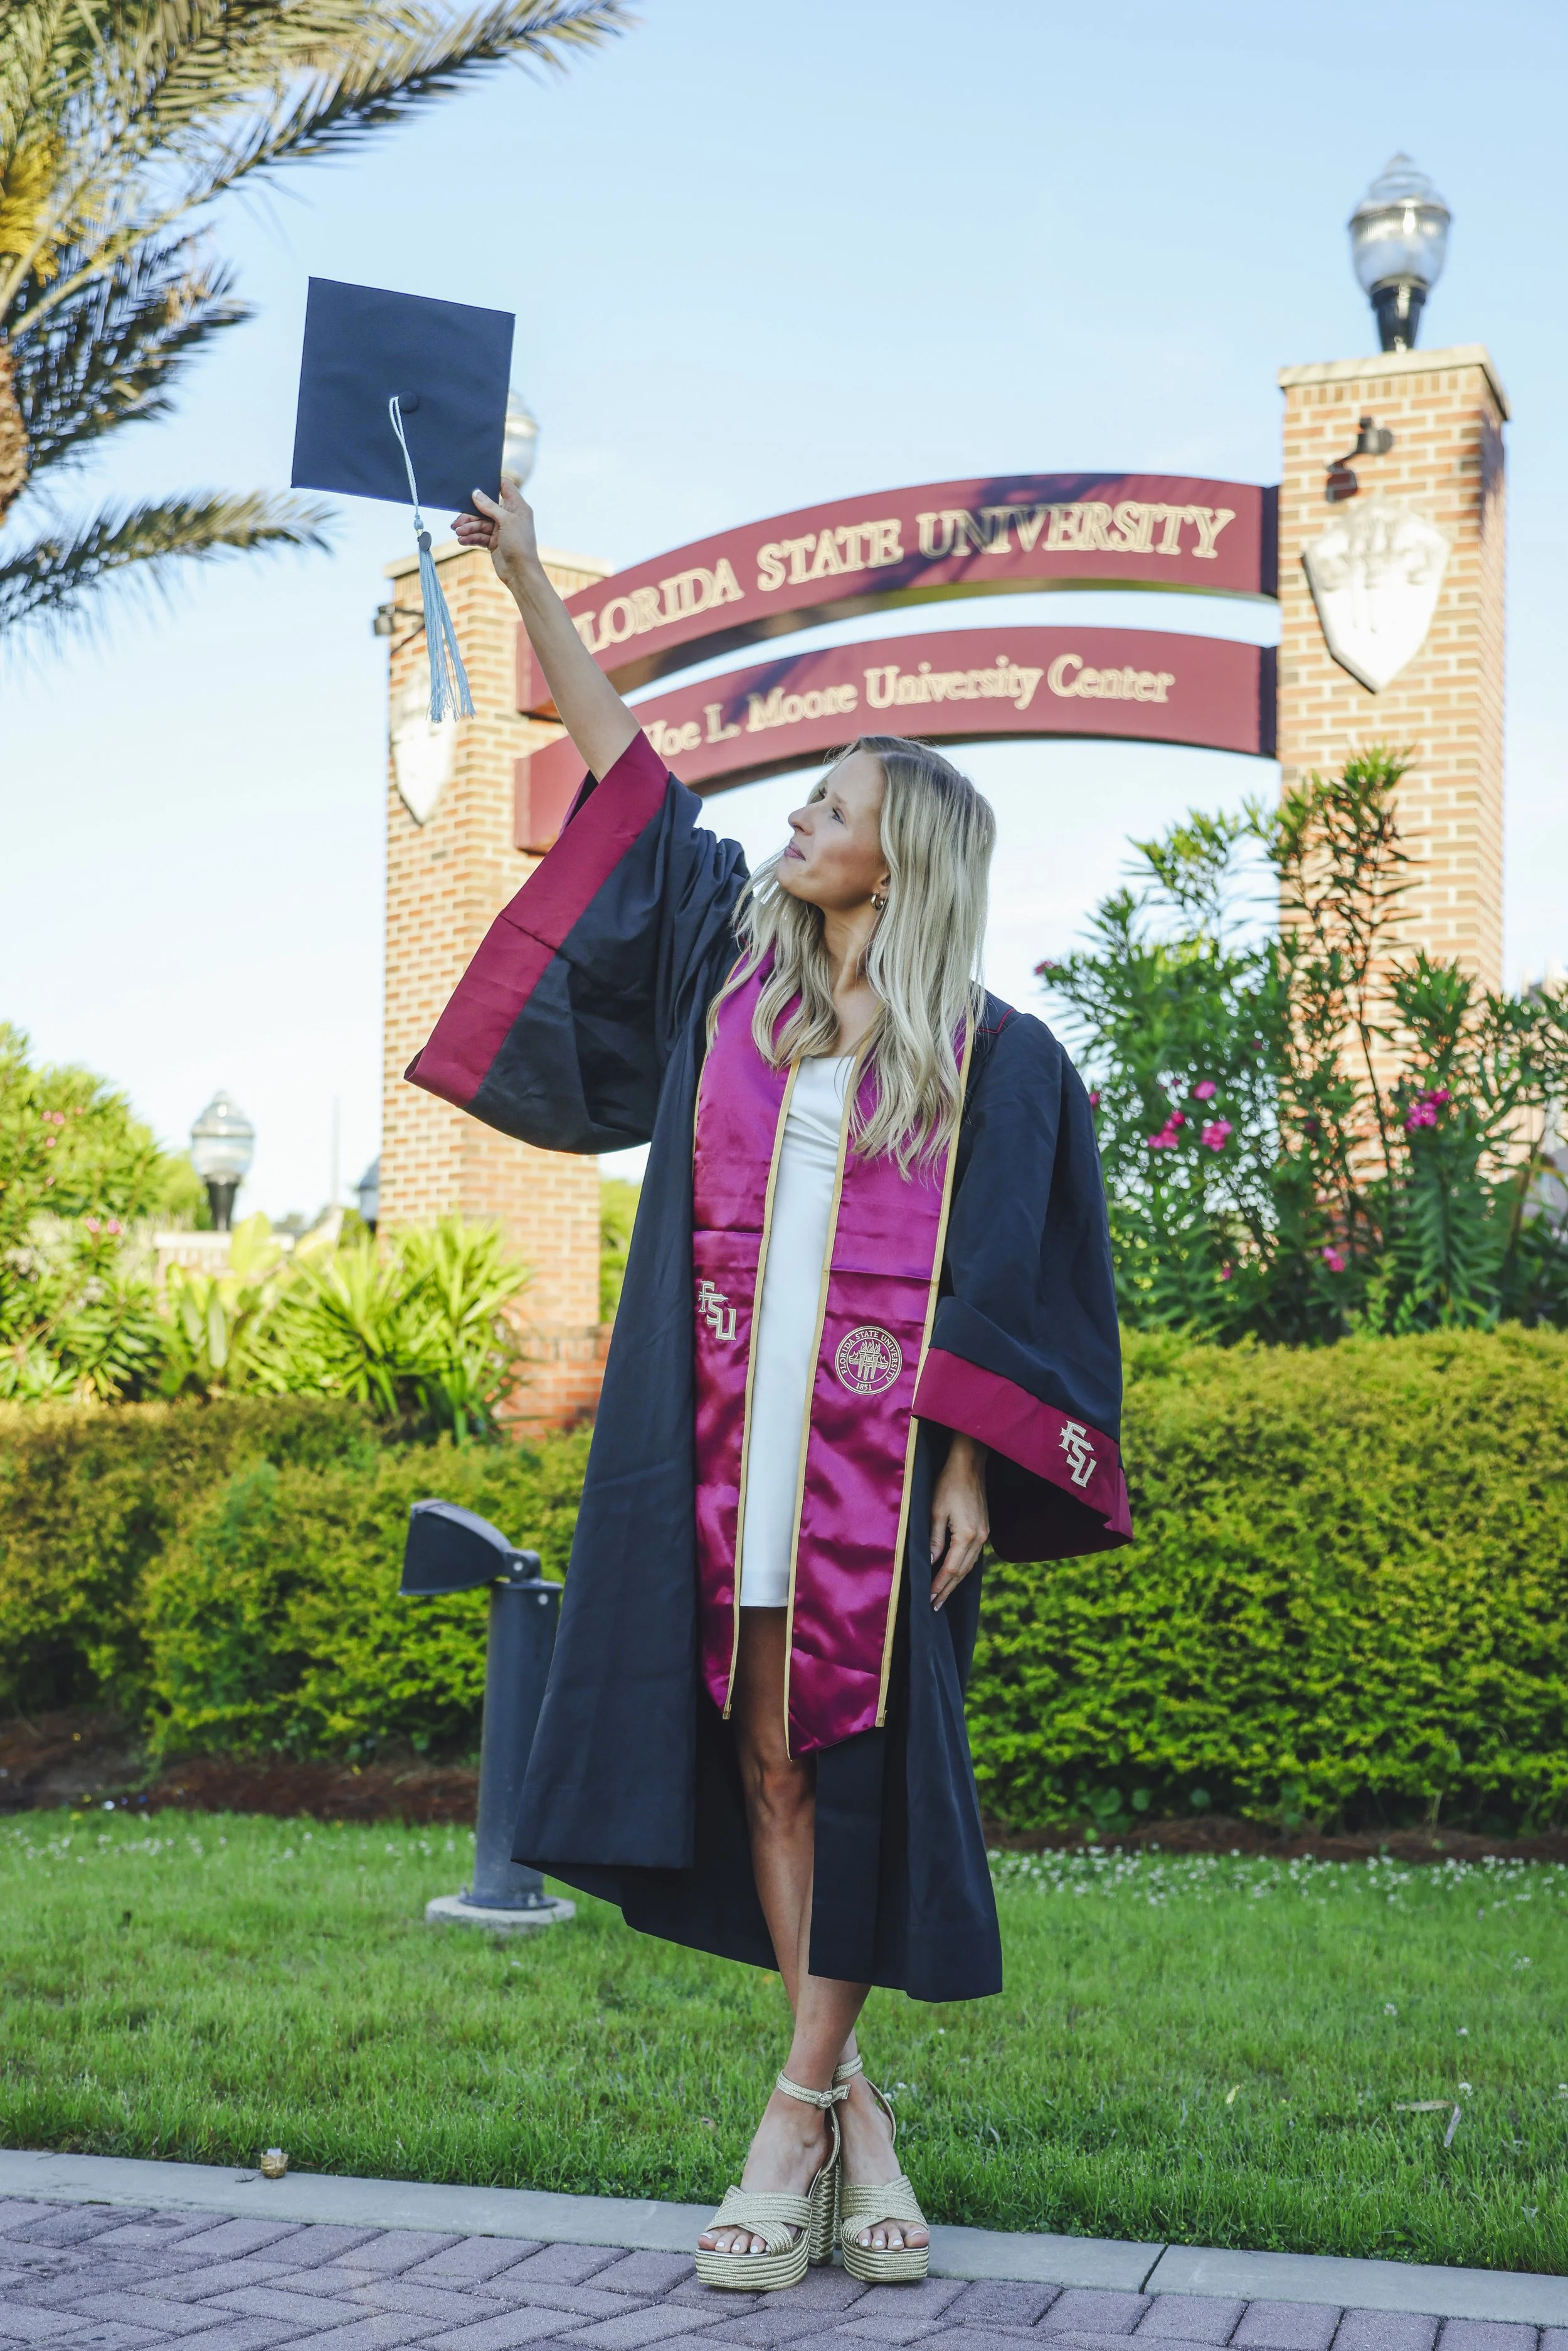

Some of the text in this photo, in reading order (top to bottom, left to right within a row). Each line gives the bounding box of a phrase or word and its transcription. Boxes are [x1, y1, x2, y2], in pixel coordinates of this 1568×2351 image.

[571, 500, 1236, 655] LORIDA STATE UNIVERSITY
[746, 685, 858, 733] Moore
[863, 654, 1044, 711] University
[1047, 653, 1177, 703] Center
[697, 1280, 737, 1340] FSU
[839, 1330, 898, 1382] FLORIDA STATE UNIVERSITY
[855, 1382, 872, 1391] 1851
[1058, 1420, 1098, 1488] FSU
